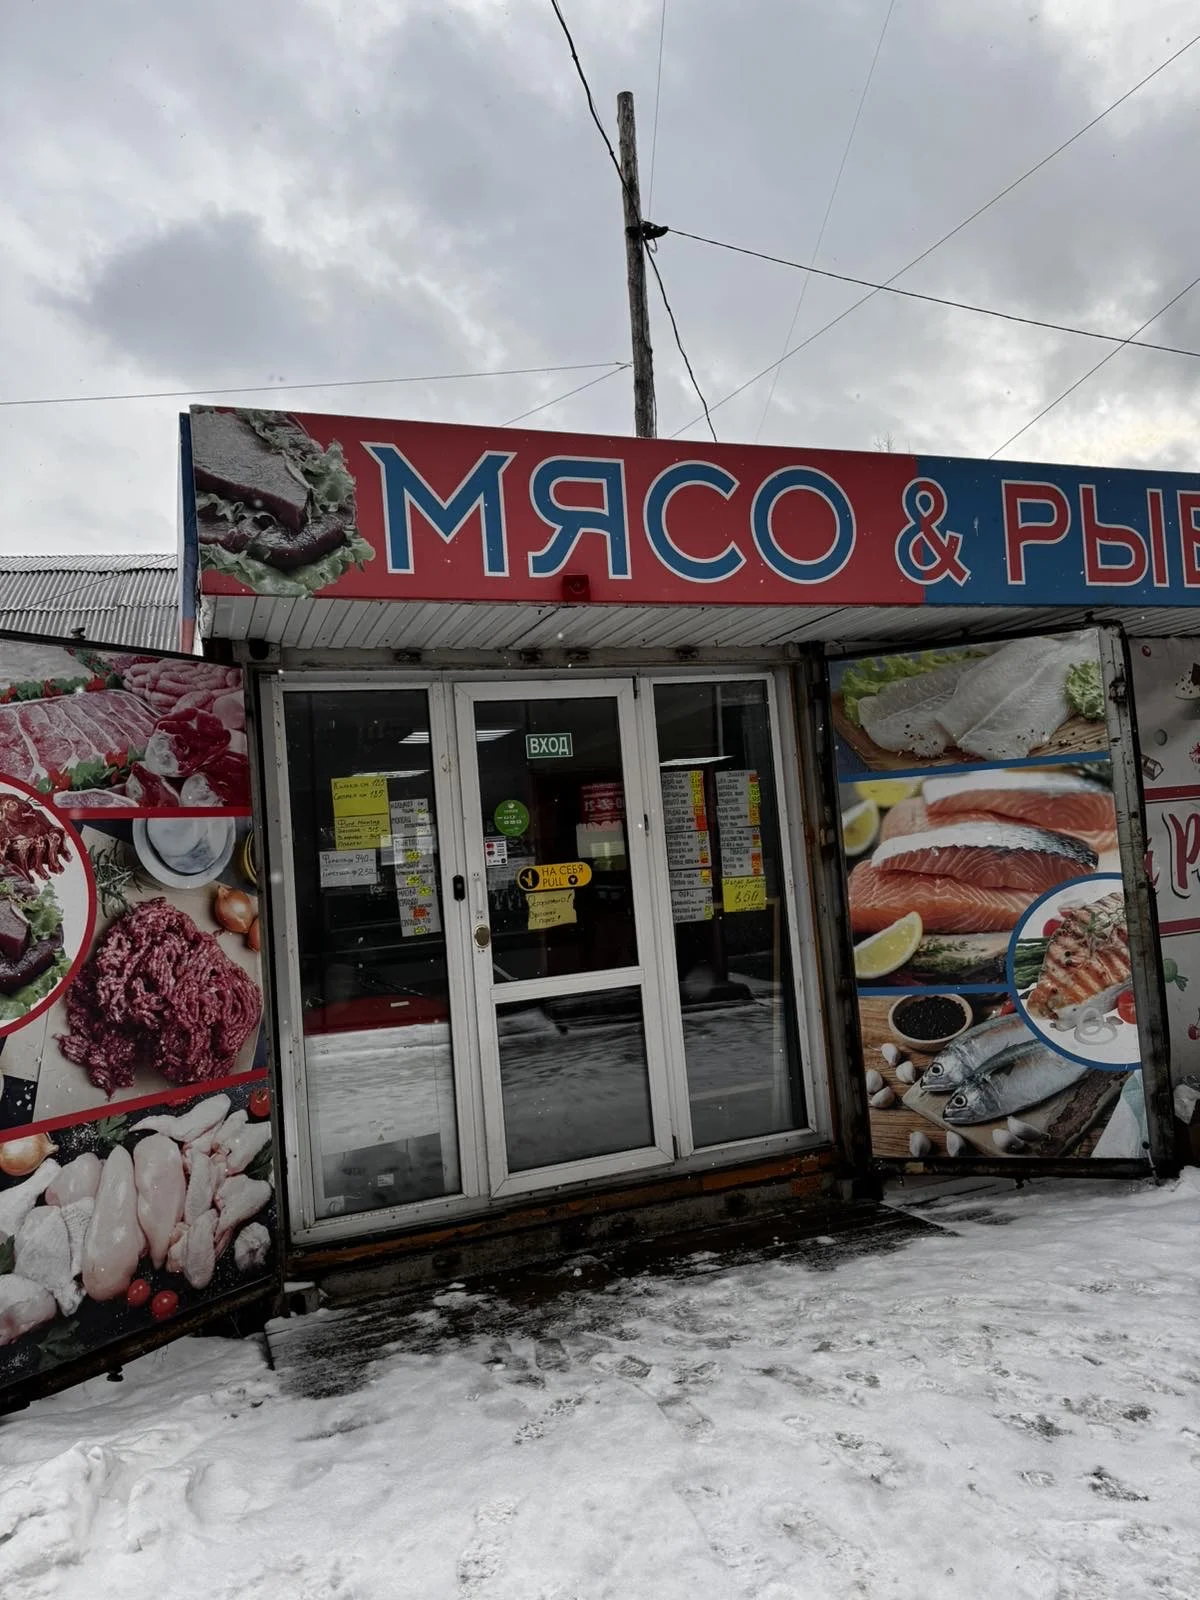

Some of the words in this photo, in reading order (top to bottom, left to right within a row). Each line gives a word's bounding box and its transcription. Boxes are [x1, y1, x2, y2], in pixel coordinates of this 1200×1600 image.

[360, 440, 857, 584] МЯСО
[895, 477, 971, 586] &
[529, 736, 569, 755] ВХОД
[542, 866, 556, 876] НА
[560, 864, 584, 875] СЕБЯ
[543, 877, 564, 887] PULL
